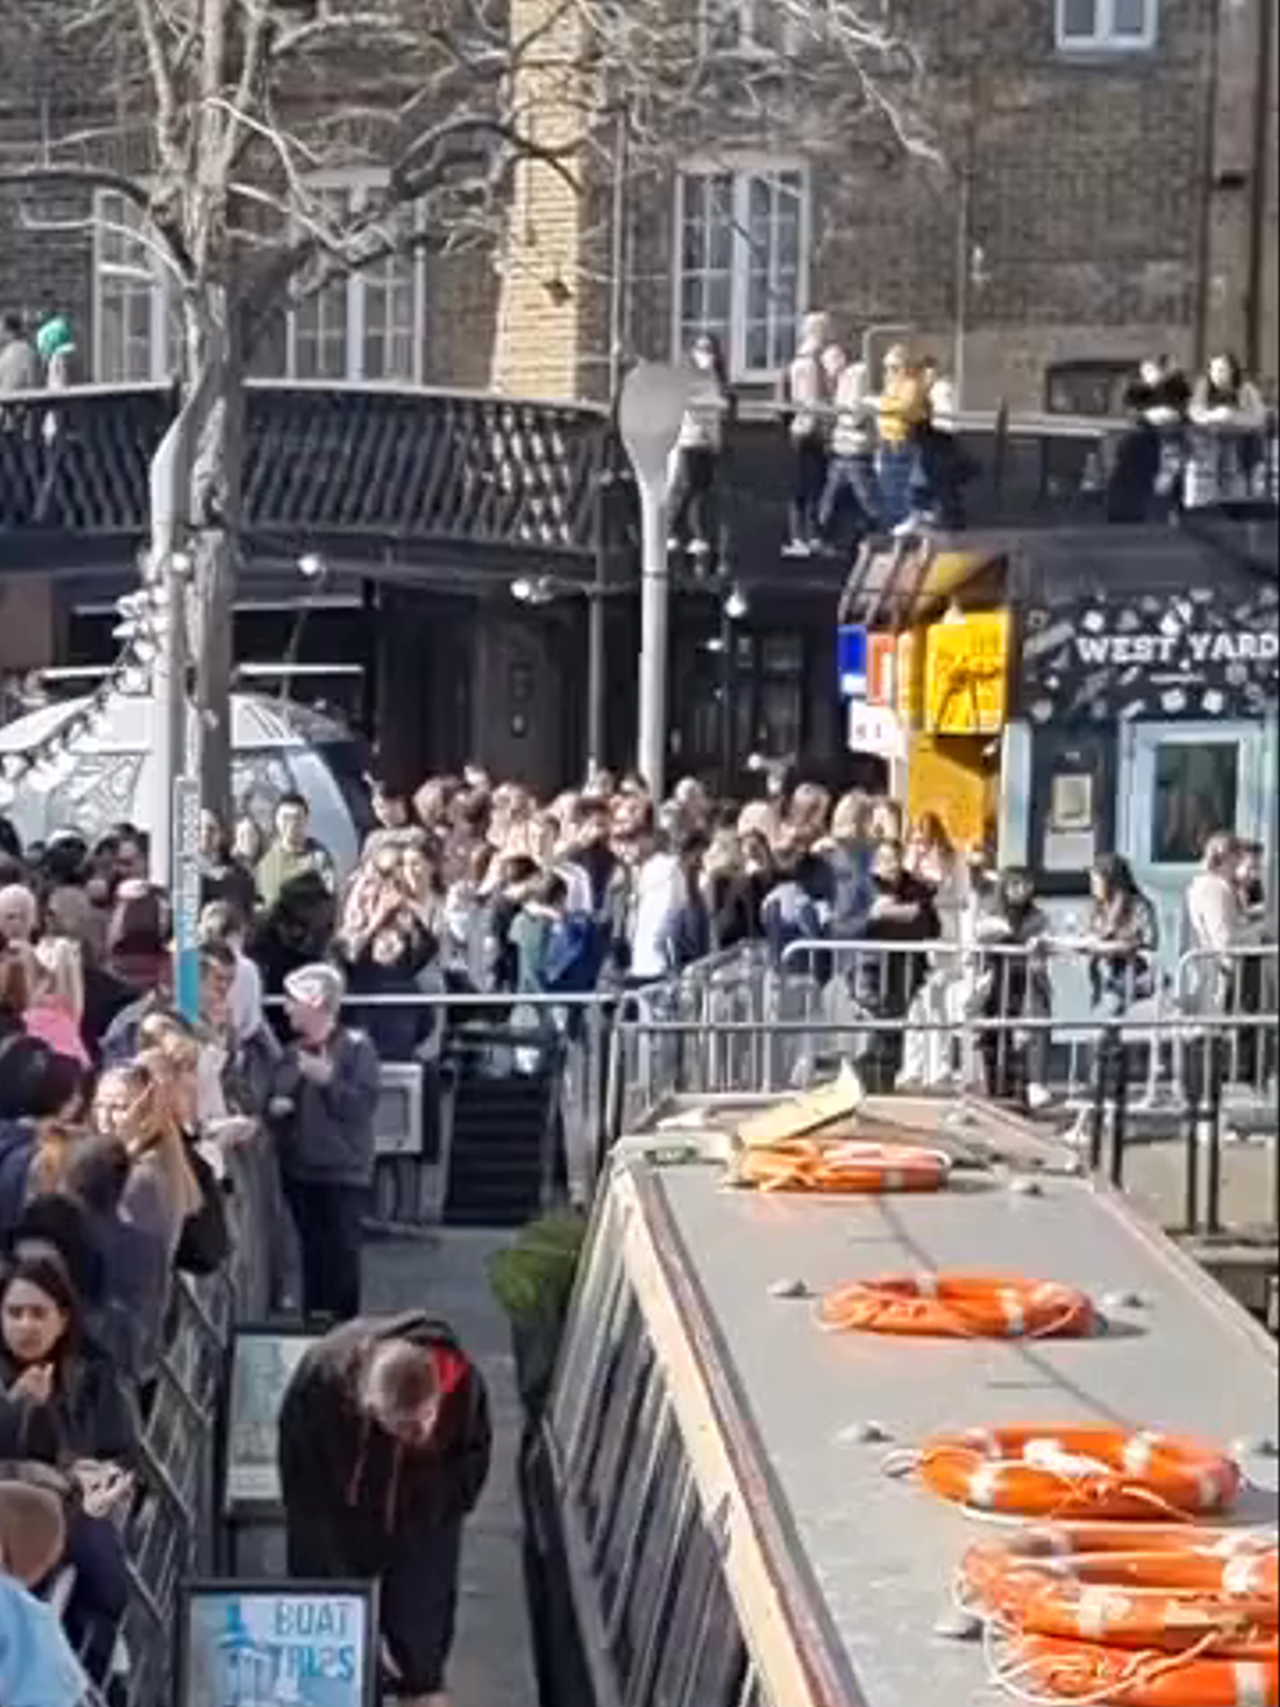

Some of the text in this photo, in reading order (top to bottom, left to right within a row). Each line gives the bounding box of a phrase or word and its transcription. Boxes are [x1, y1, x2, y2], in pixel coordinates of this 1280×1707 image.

[1076, 633, 1279, 664] WEST YARD
[275, 1599, 349, 1635] BOAT
